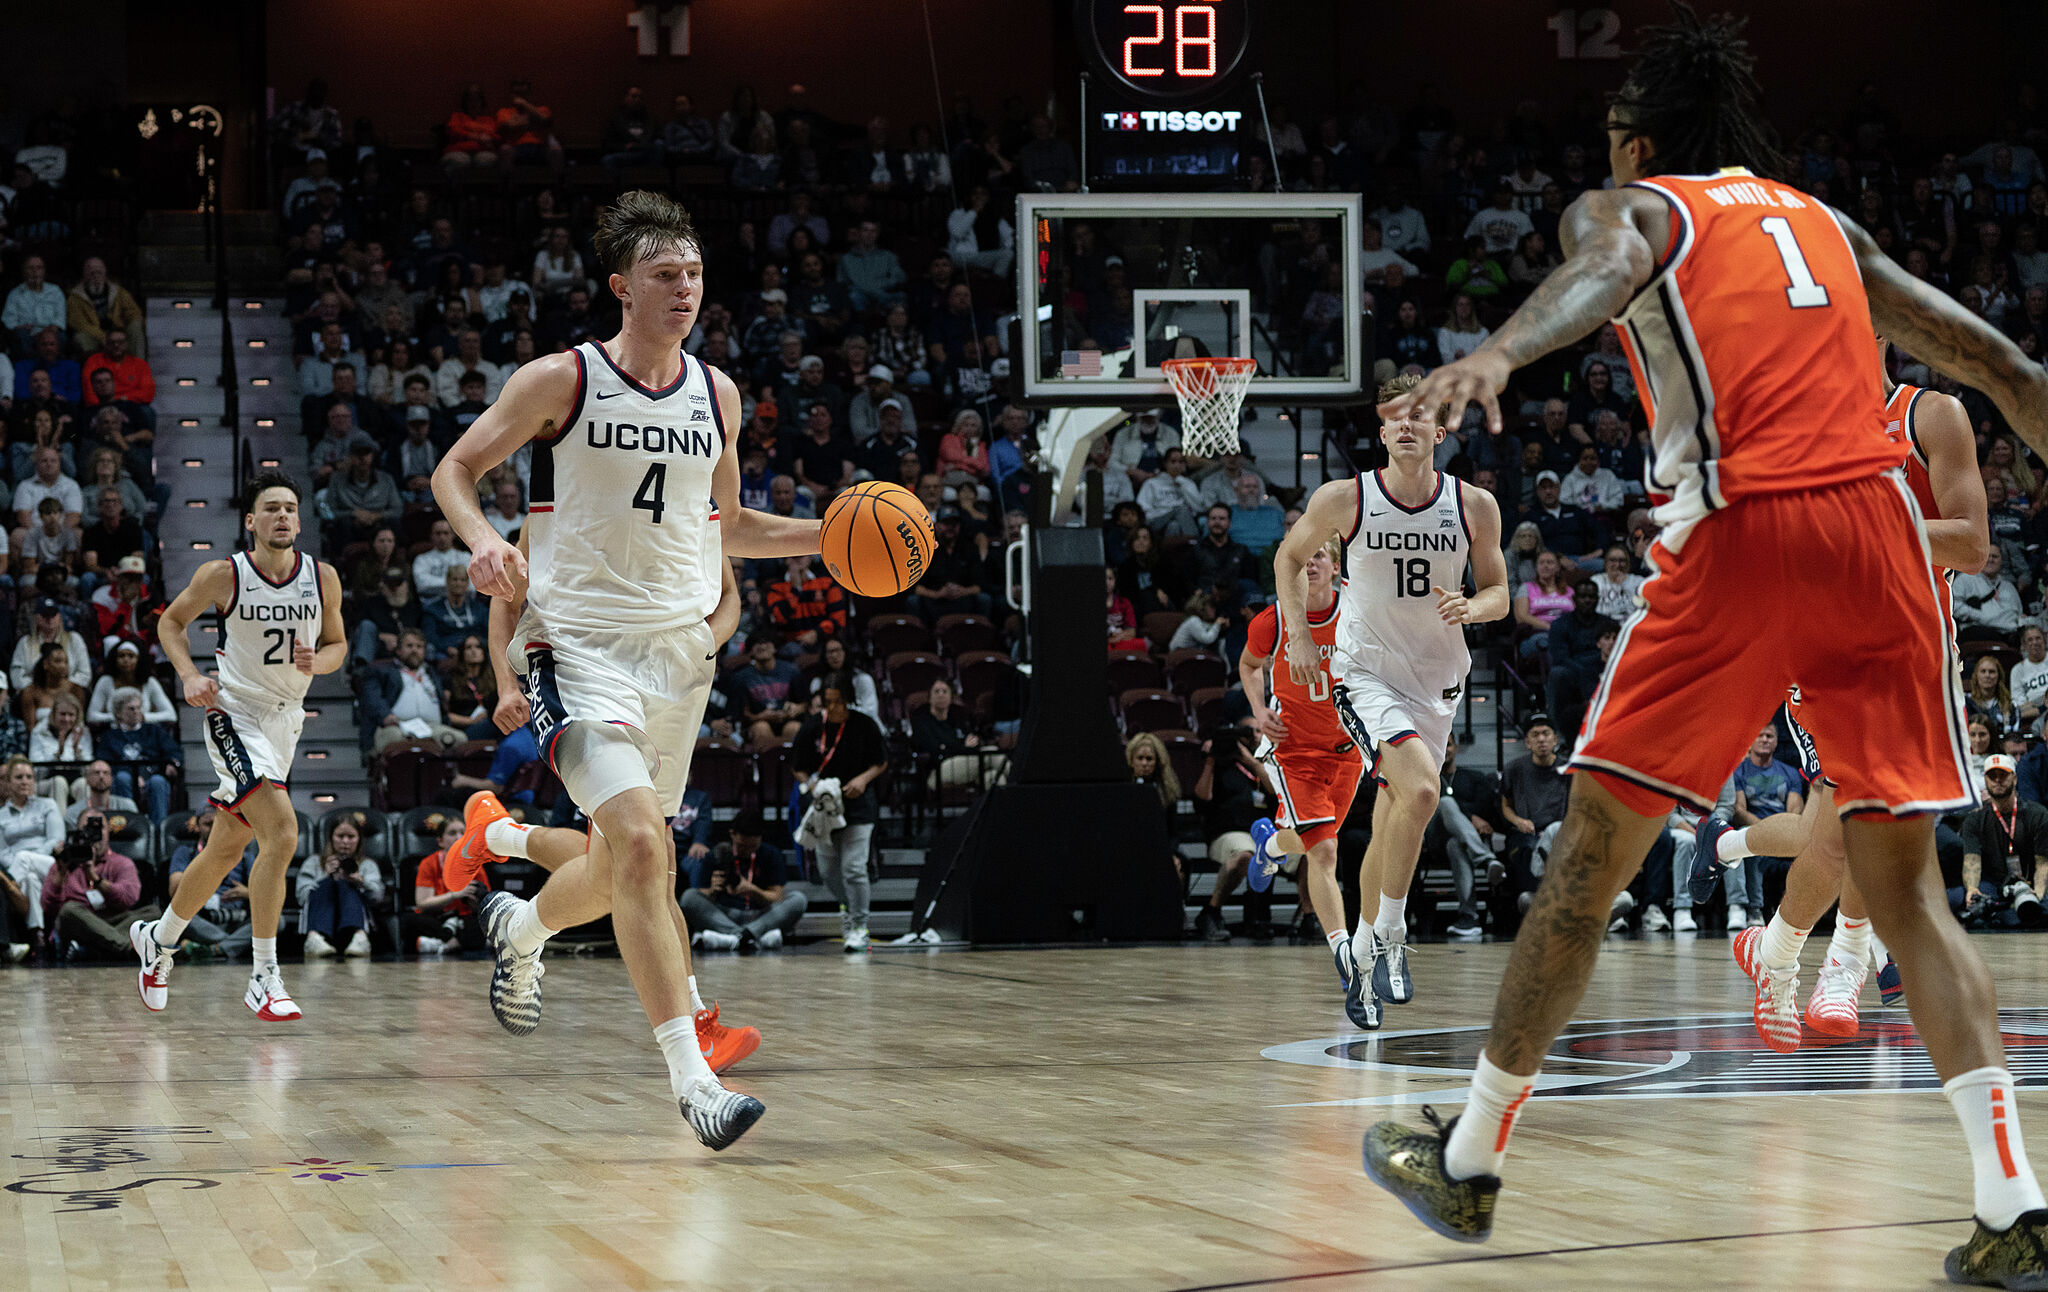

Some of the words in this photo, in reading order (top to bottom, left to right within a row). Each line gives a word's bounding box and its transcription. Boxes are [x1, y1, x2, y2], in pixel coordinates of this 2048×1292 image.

[627, 5, 690, 56] 11
[1123, 4, 1216, 76] 28
[1546, 8, 1621, 59] 12
[1140, 111, 1242, 131] TISSOT
[1704, 182, 1779, 207] WHITE
[1760, 216, 1831, 309] 1
[587, 421, 712, 458] UCONN
[632, 462, 667, 524] 4
[1366, 531, 1457, 552] UCONN
[1393, 558, 1431, 598] 18
[239, 604, 317, 621] UCONN
[263, 628, 297, 665] 21
[213, 714, 249, 787] HUSKIES
[1797, 725, 1821, 773] SKIES
[10, 1125, 225, 1178] Mohegan
[3, 1177, 223, 1214] Sun
